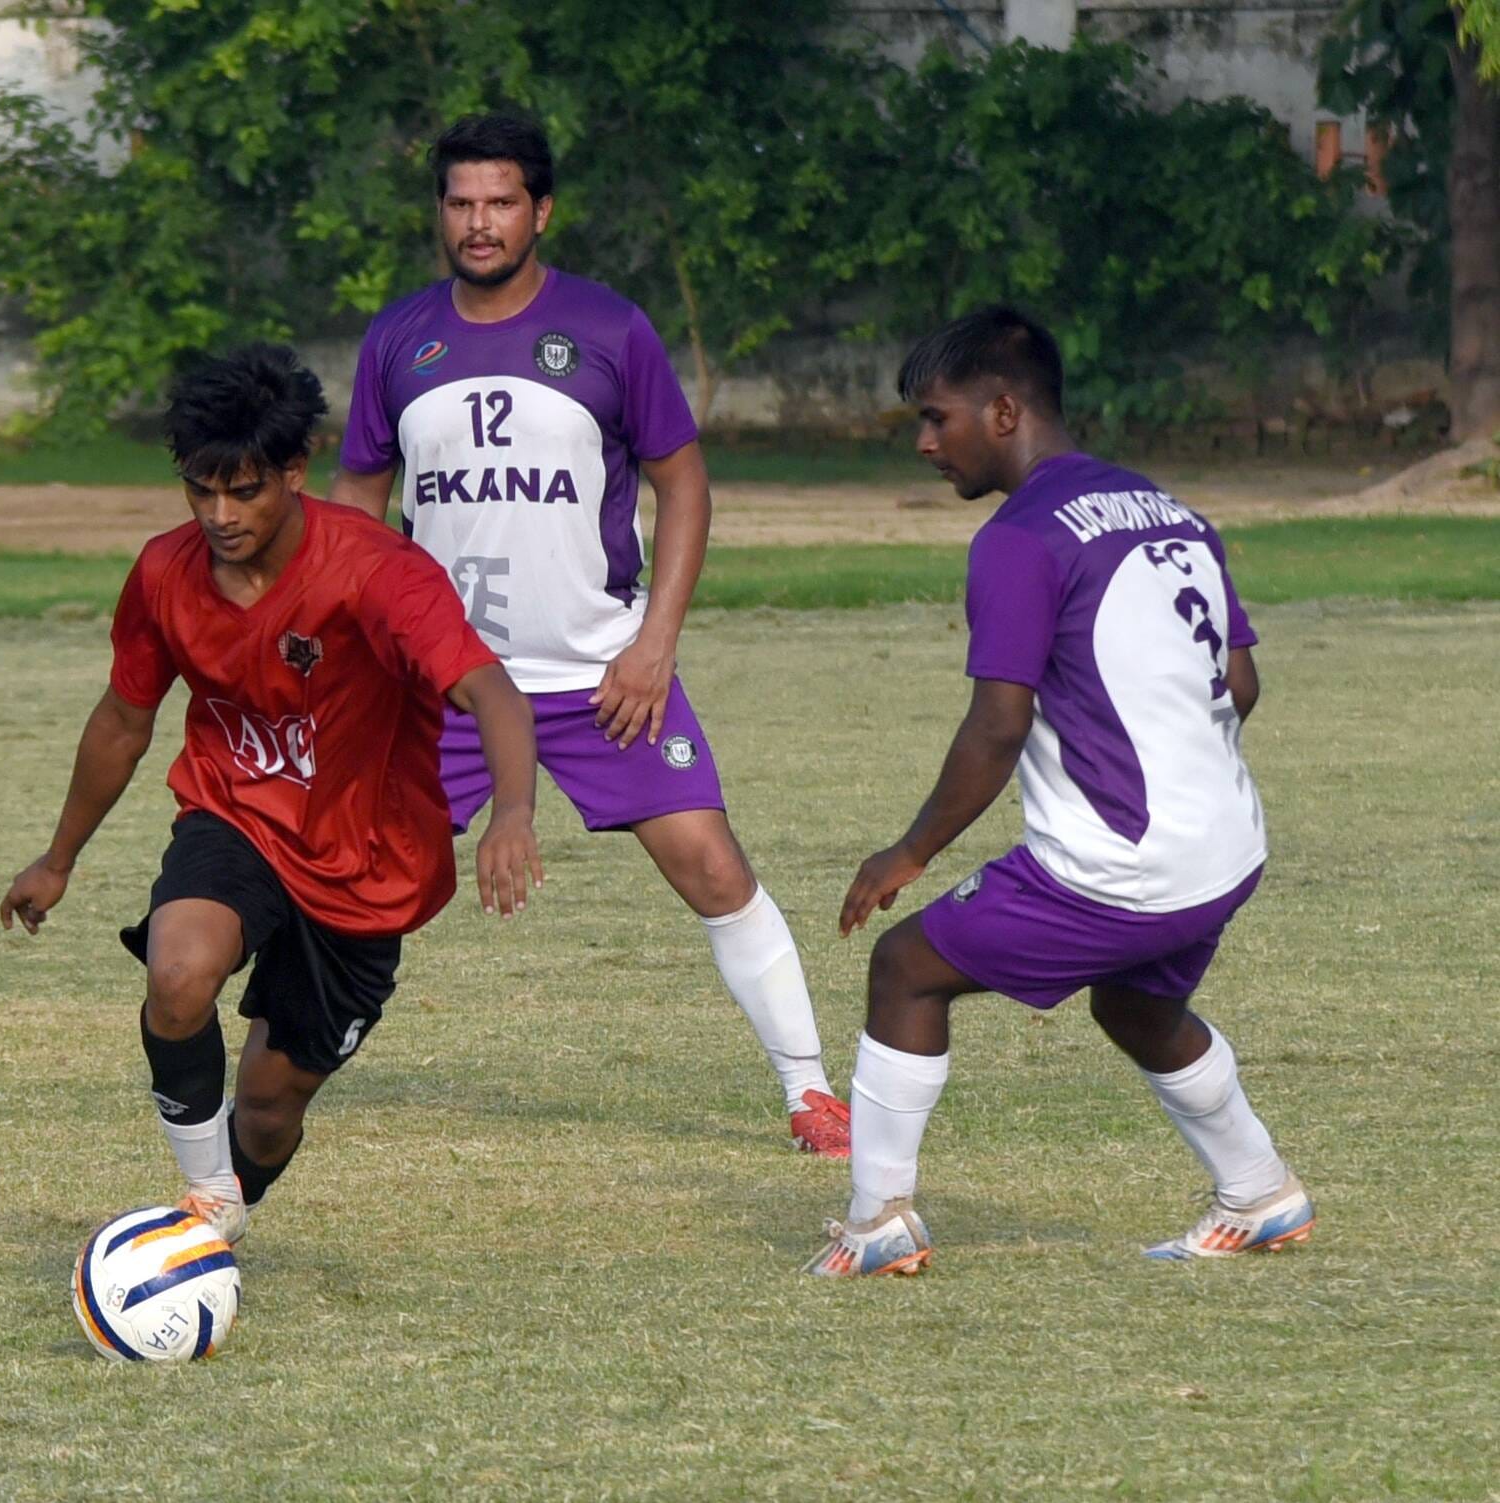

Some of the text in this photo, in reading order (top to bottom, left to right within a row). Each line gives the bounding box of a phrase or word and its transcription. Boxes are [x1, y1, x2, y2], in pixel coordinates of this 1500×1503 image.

[462, 389, 514, 448] 12
[416, 467, 579, 506] EKANA
[235, 713, 313, 779] AIG
[338, 1018, 366, 1056] 6
